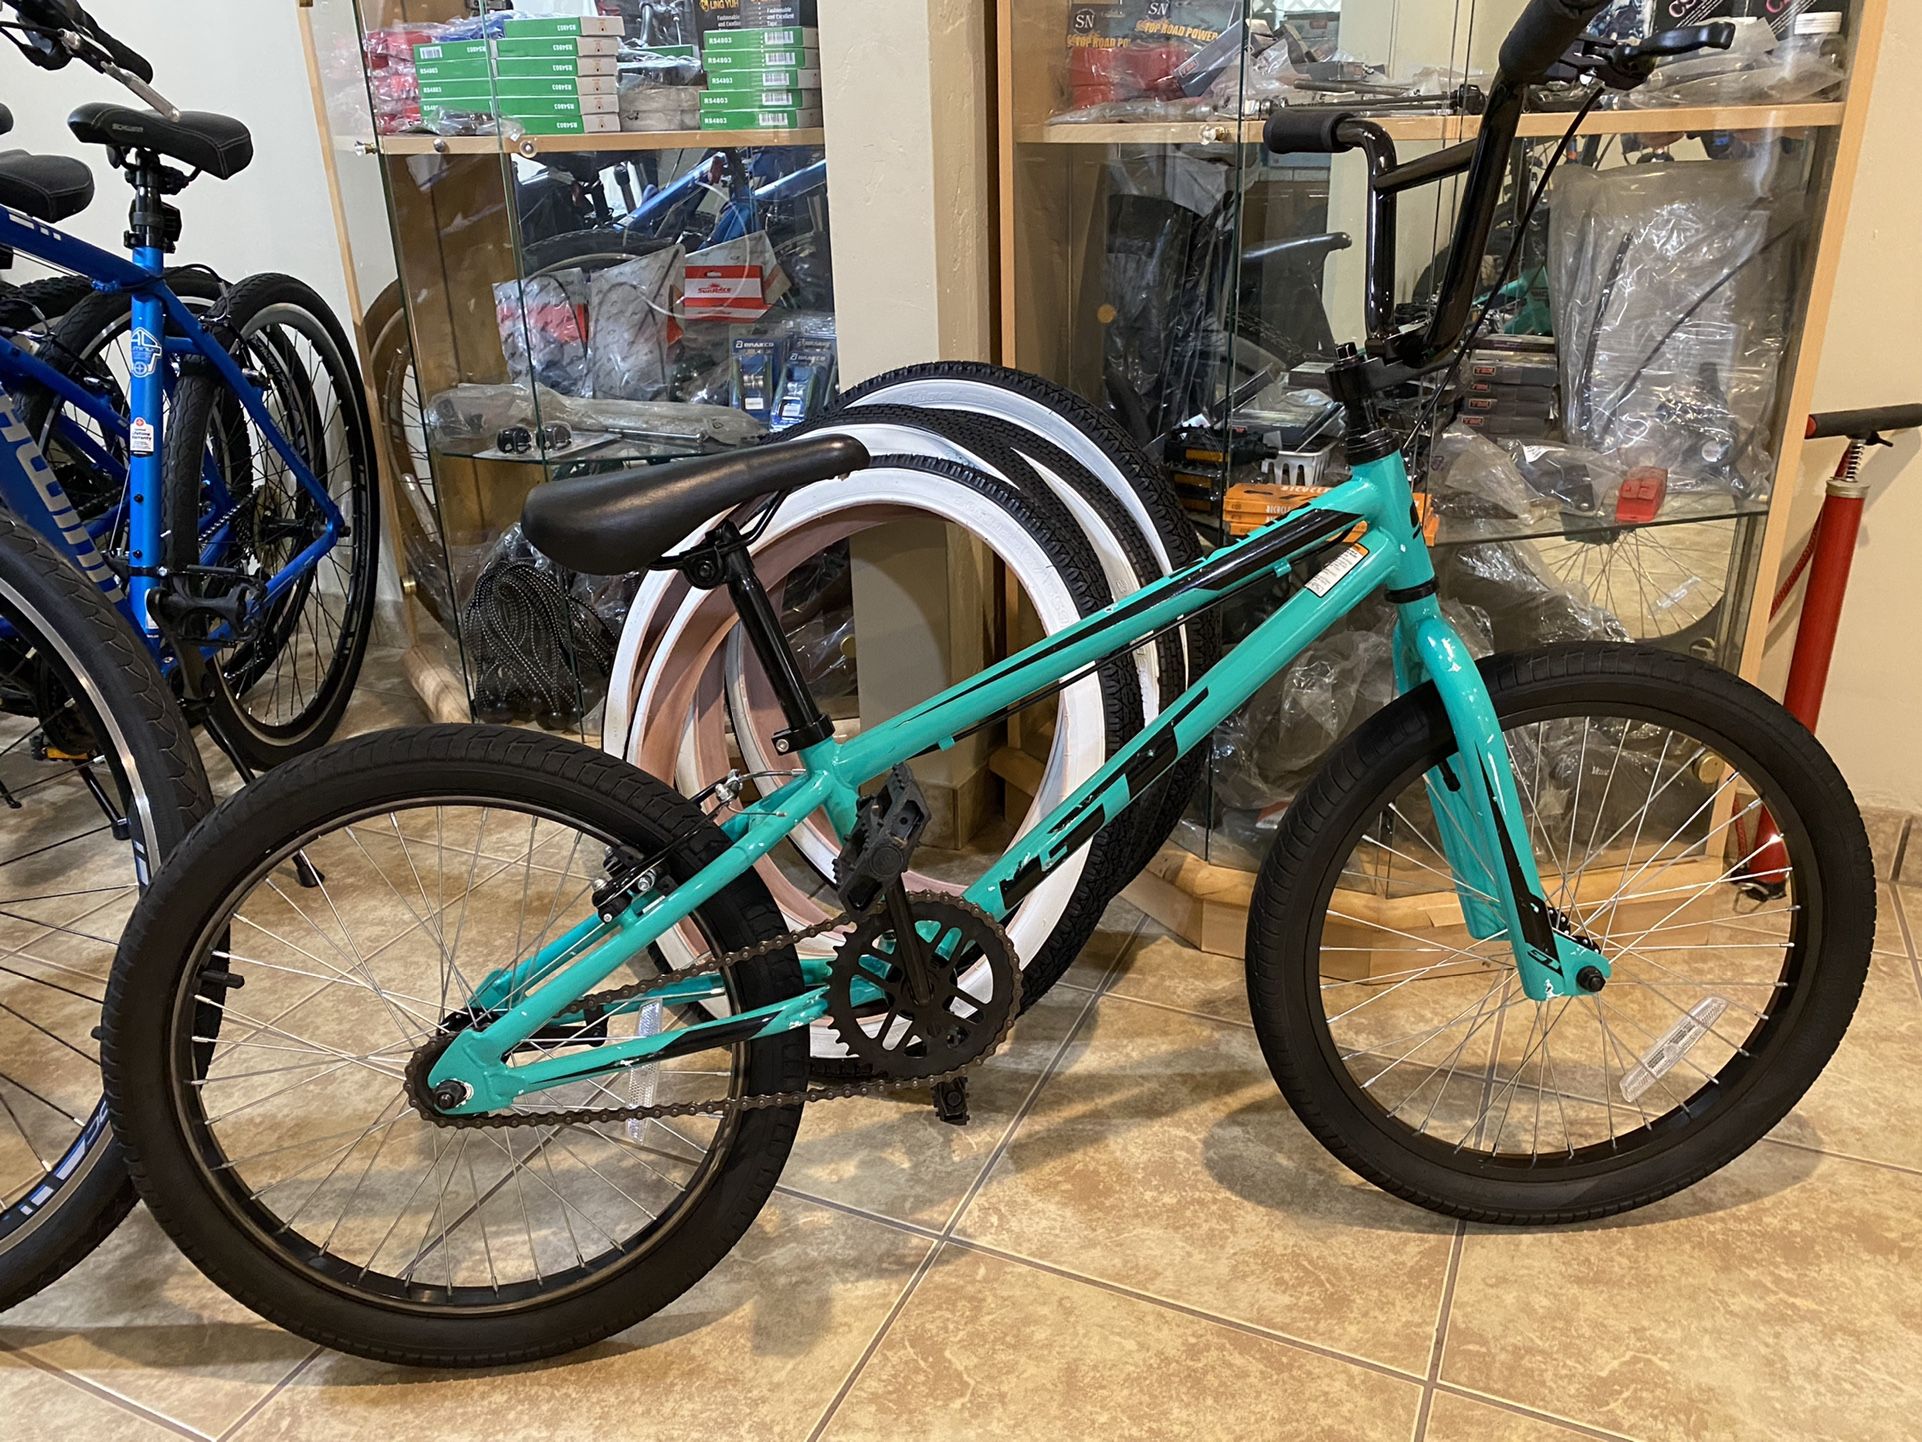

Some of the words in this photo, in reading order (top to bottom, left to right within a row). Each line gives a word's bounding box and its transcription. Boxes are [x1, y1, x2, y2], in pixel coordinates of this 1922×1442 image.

[1148, 2, 1169, 15] SN
[1075, 14, 1095, 29] SN
[1161, 23, 1186, 35] ROAD
